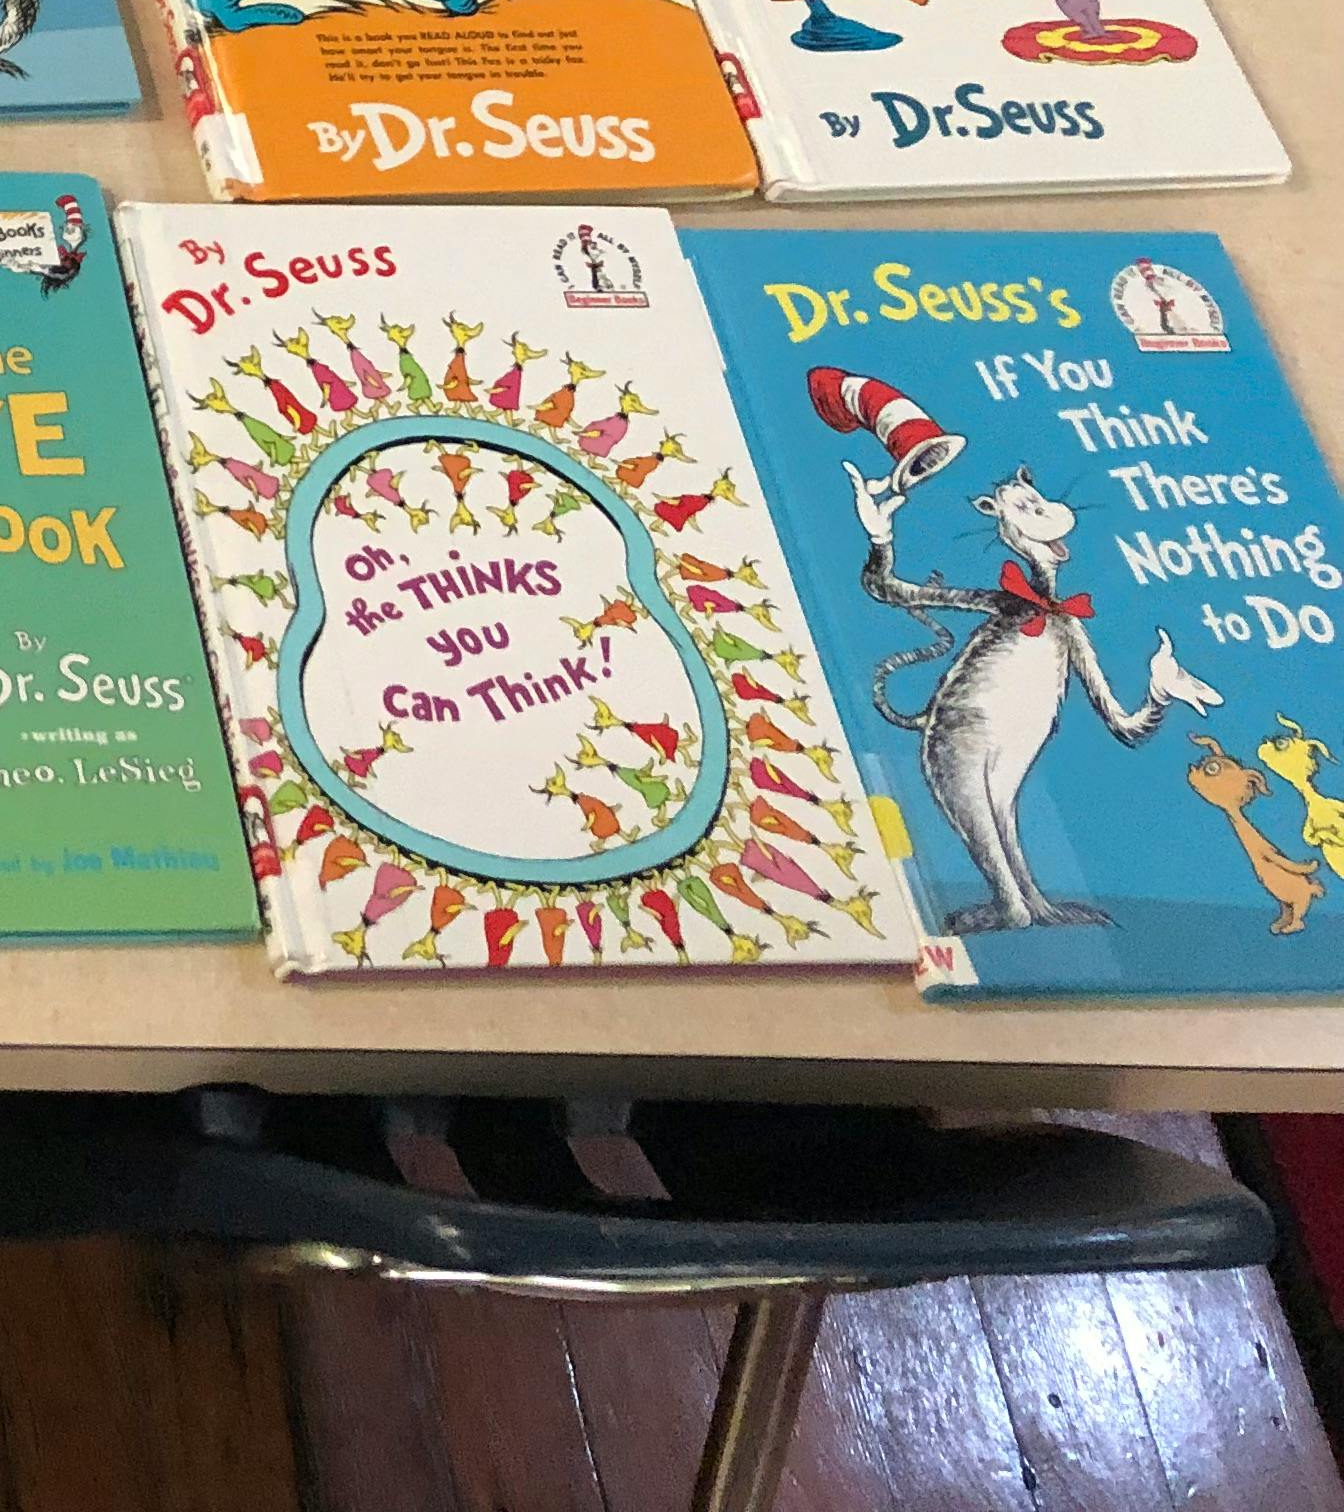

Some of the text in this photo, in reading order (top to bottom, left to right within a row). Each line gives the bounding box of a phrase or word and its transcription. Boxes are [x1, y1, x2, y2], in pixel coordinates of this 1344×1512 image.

[179, 238, 226, 269] By
[161, 241, 399, 337] Dr. Seuss
[763, 281, 868, 344] Dr.
[873, 261, 1083, 330] Seuss's
[974, 349, 1113, 402] If You
[1058, 399, 1210, 453] Think
[1108, 465, 1289, 513] There's
[344, 544, 412, 584] Oh,
[1115, 523, 1342, 592] Nothing
[14, 631, 47, 653] By
[344, 595, 404, 638] the
[1203, 595, 1335, 650] to Do
[427, 621, 512, 668] you
[57, 653, 185, 711] Seuss
[381, 636, 613, 725] Can Think!
[73, 757, 201, 792] LeSieg
